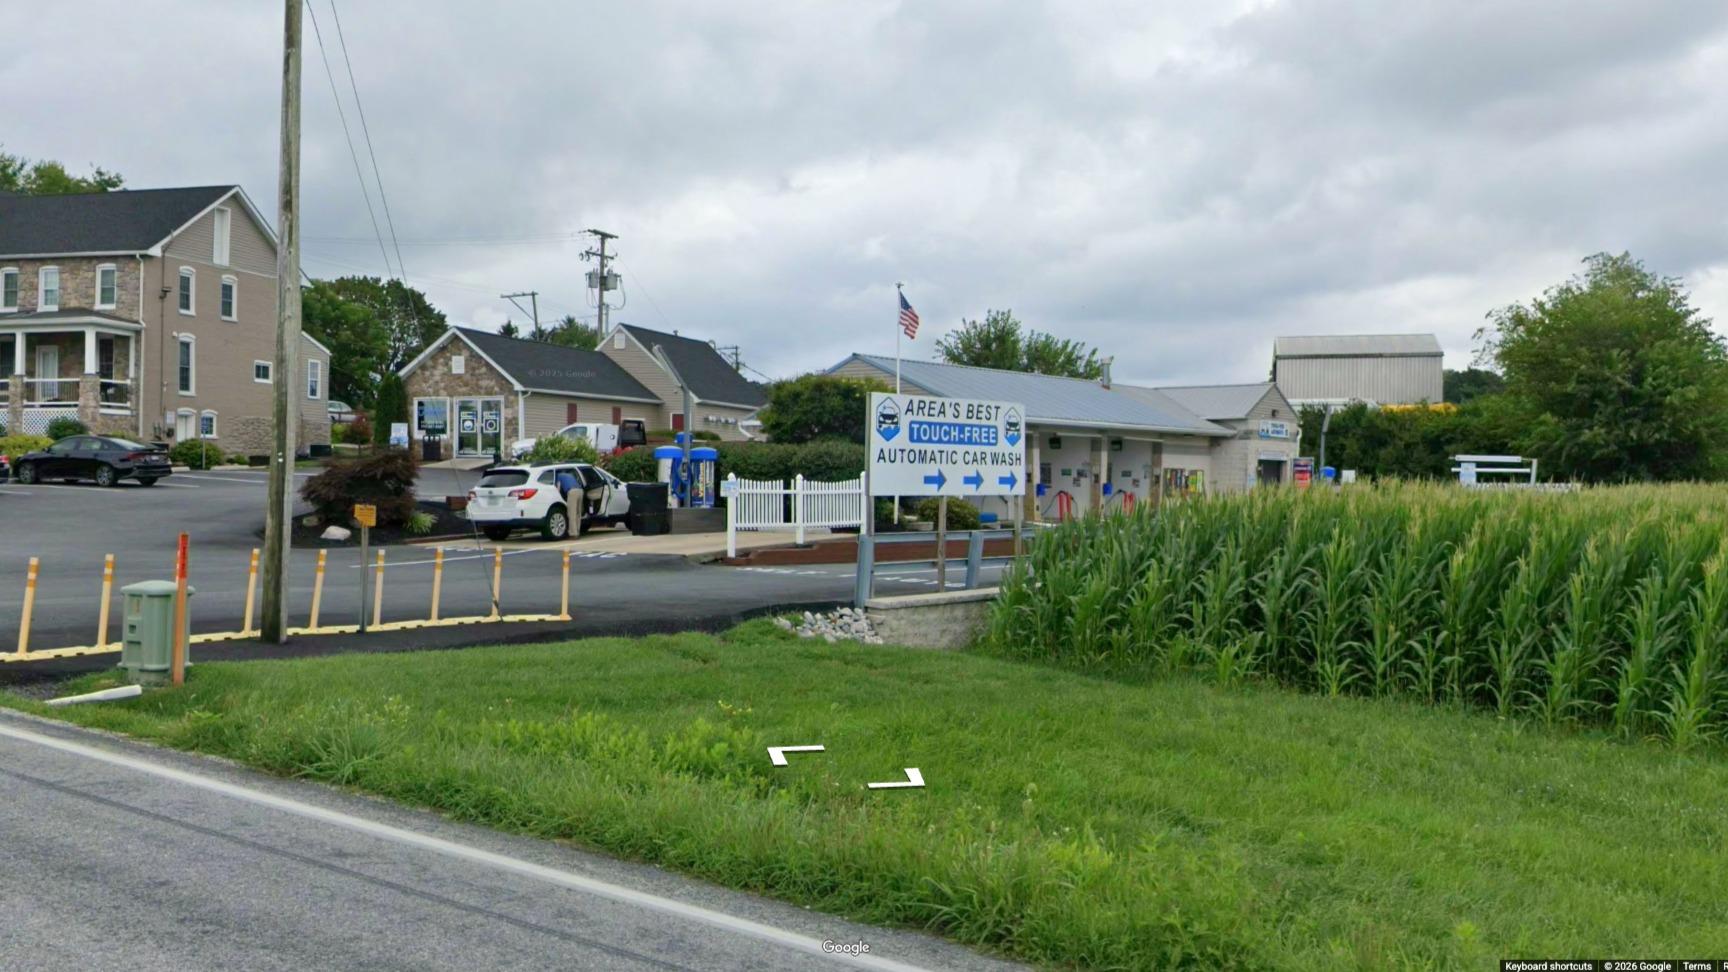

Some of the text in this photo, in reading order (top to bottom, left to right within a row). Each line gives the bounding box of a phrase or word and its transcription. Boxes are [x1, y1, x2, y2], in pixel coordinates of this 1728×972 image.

[904, 399, 1001, 421] AREA'S BEST
[912, 424, 997, 443] TOUCH-FREE
[877, 448, 1022, 466] AUTOMATIC CAR WASH
